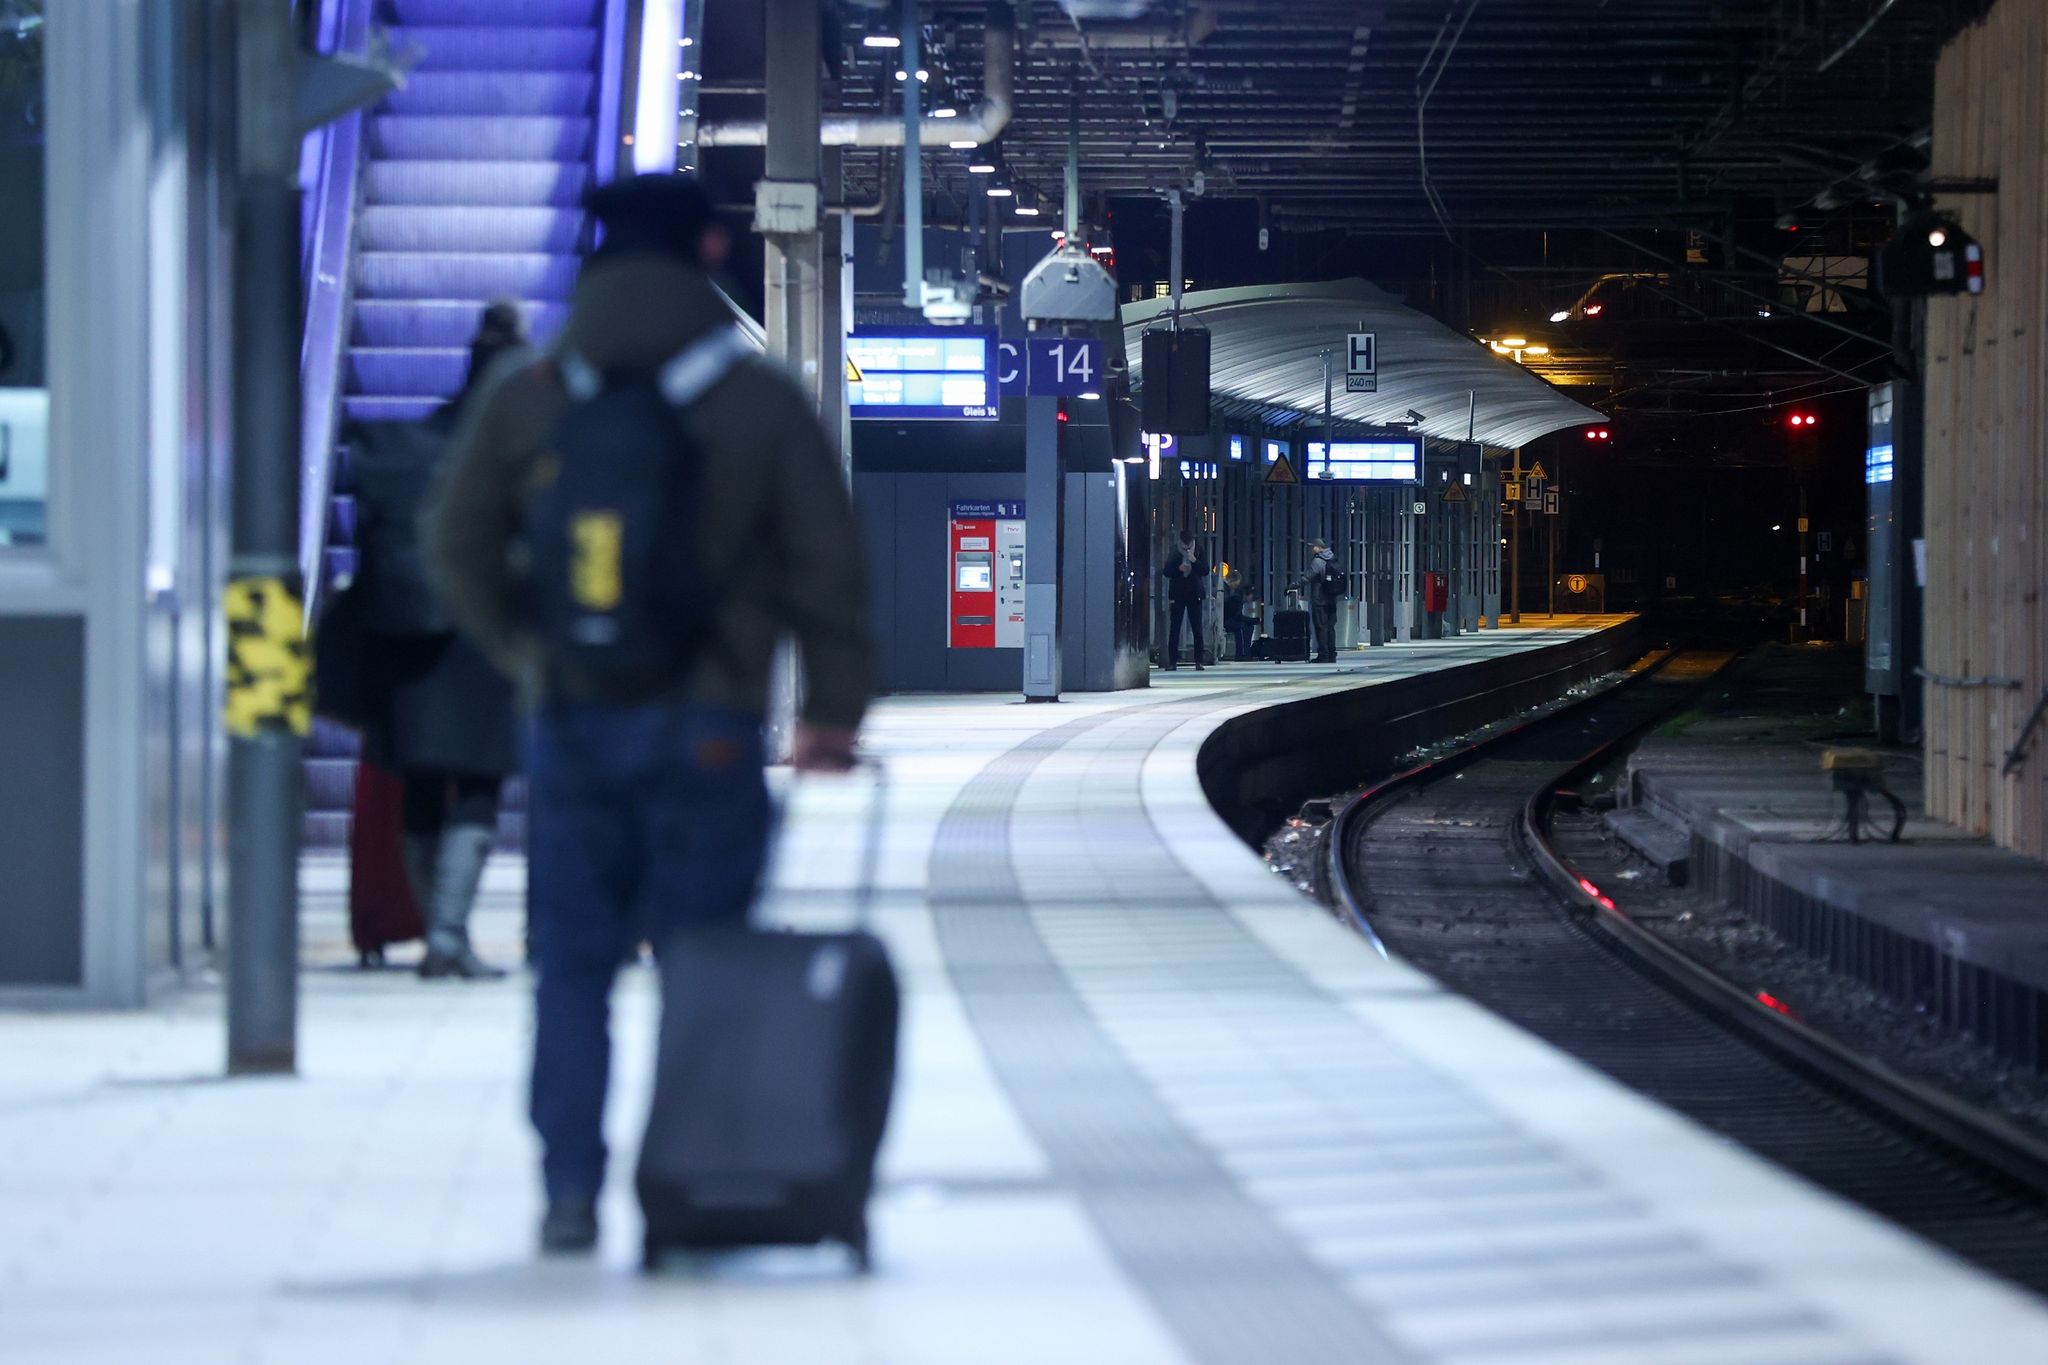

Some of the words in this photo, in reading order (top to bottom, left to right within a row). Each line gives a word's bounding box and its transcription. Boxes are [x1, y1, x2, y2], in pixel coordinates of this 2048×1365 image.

[999, 344, 1019, 383] C
[1049, 344, 1094, 383] 14
[1350, 337, 1372, 370] H
[963, 407, 986, 417] Gleis
[988, 407, 997, 417] 14
[1528, 479, 1540, 498] H
[1545, 494, 1557, 513] H
